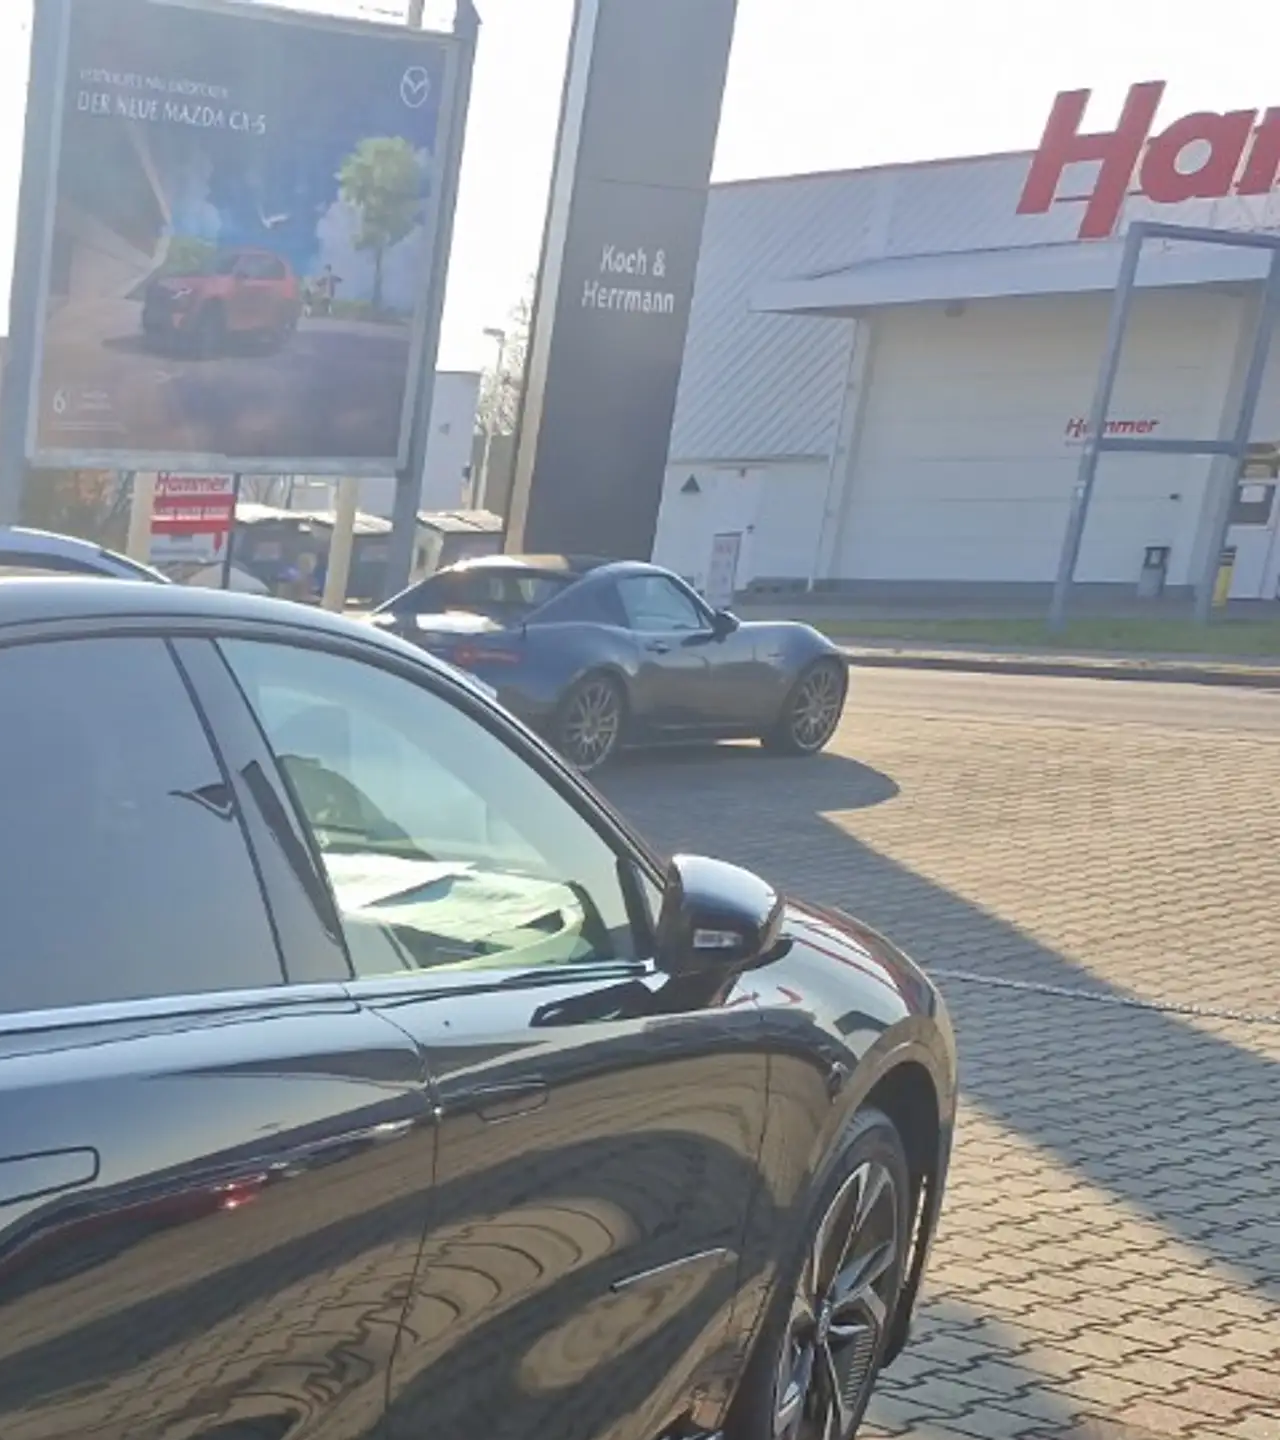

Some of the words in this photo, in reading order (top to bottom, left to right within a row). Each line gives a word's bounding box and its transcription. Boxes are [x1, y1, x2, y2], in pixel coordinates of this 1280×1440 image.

[77, 90, 111, 115] DER
[117, 94, 158, 121] NEUE
[162, 99, 227, 130] MAZDA
[600, 243, 648, 276] Koch
[651, 247, 666, 278] &
[581, 279, 675, 315] Herrmann
